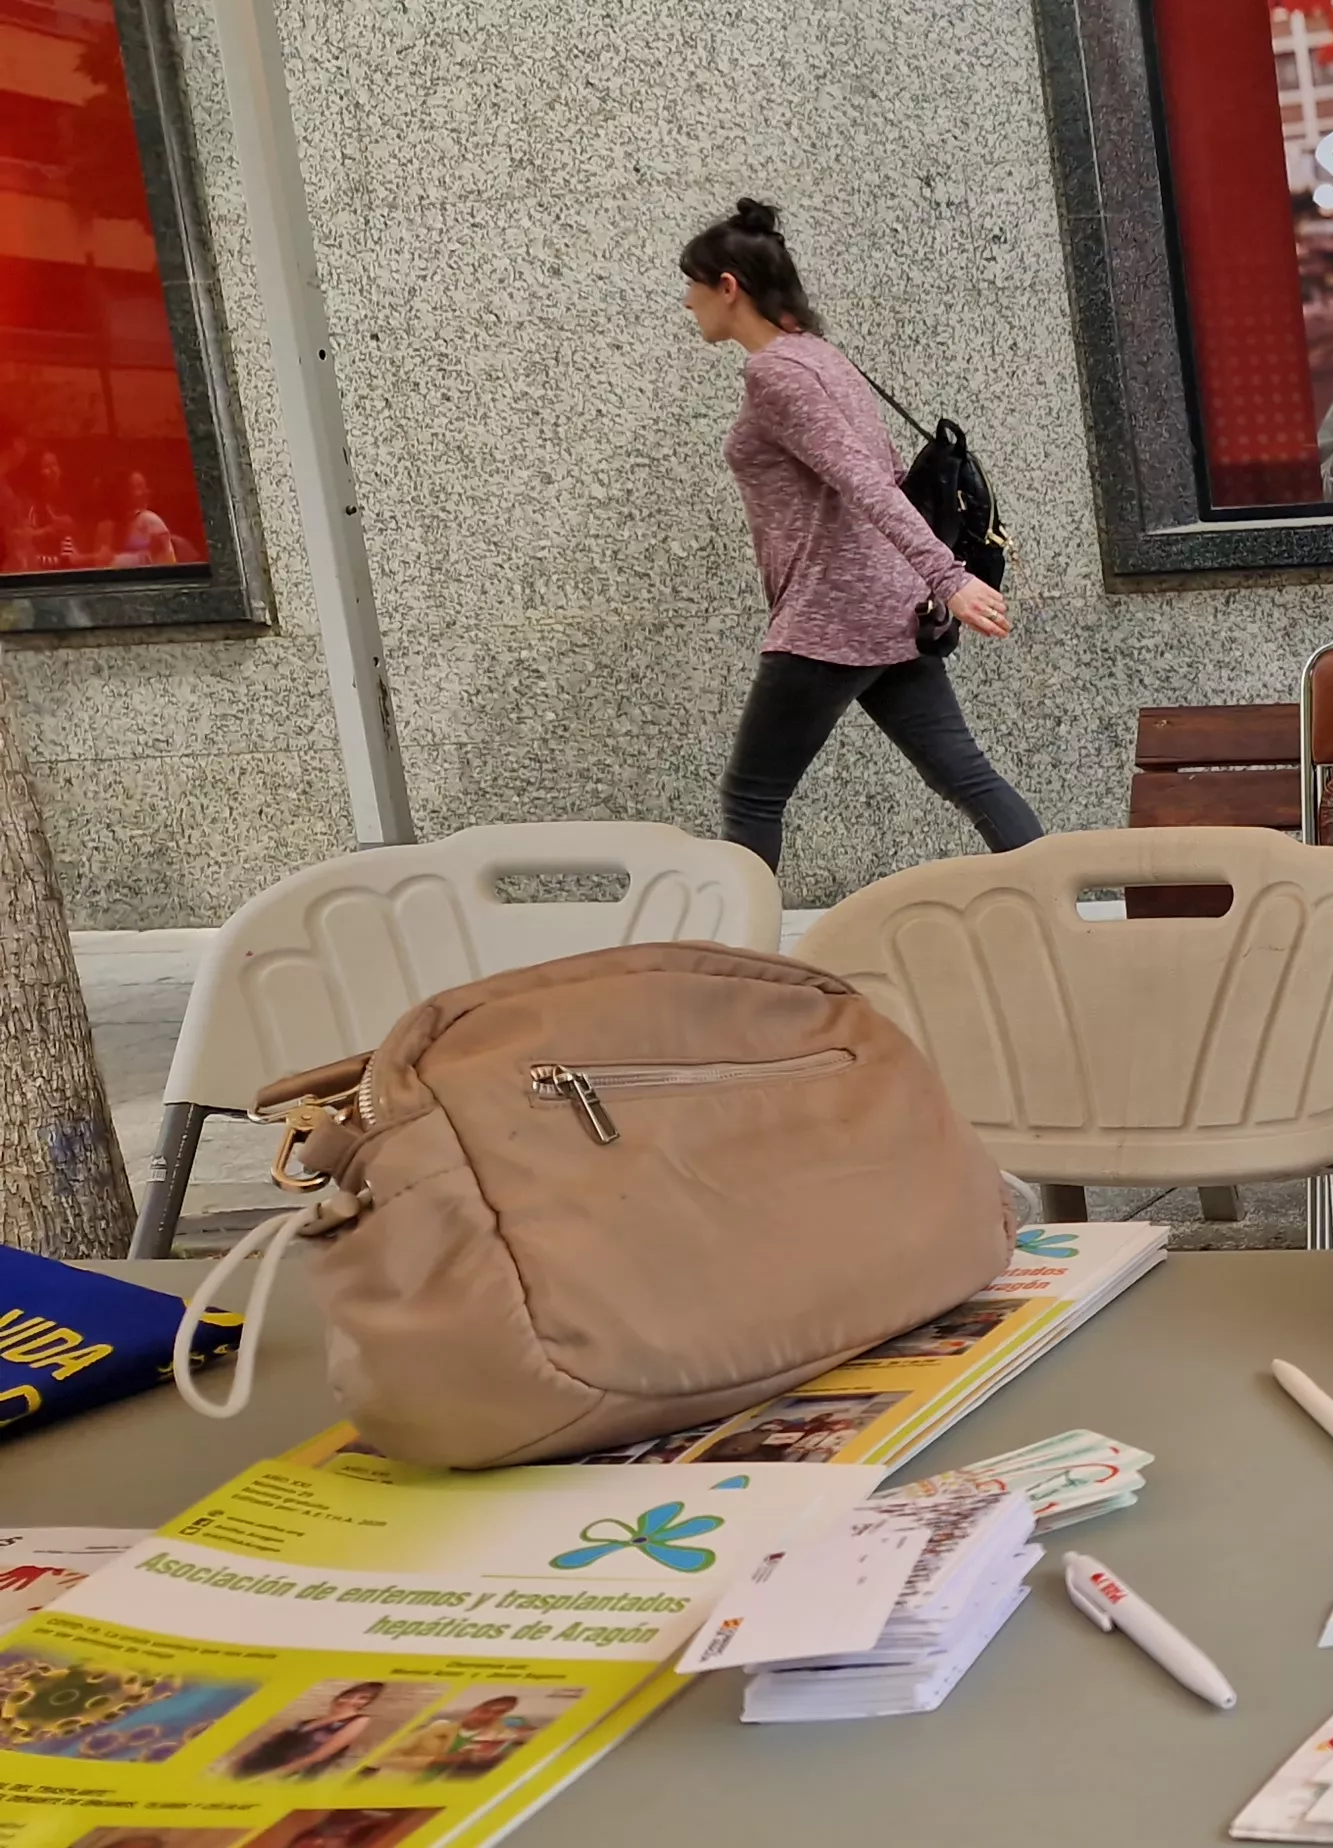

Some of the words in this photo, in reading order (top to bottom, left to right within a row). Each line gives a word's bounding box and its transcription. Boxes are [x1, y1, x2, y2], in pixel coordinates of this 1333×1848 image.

[135, 1551, 297, 1597] Asociación
[294, 1581, 339, 1601] de
[336, 1584, 472, 1608] enfermos
[464, 1592, 499, 1613] y
[495, 1589, 691, 1615] trasplantados
[364, 1615, 511, 1641] hepáticos
[510, 1620, 554, 1642] de
[552, 1621, 661, 1648] Aragón
